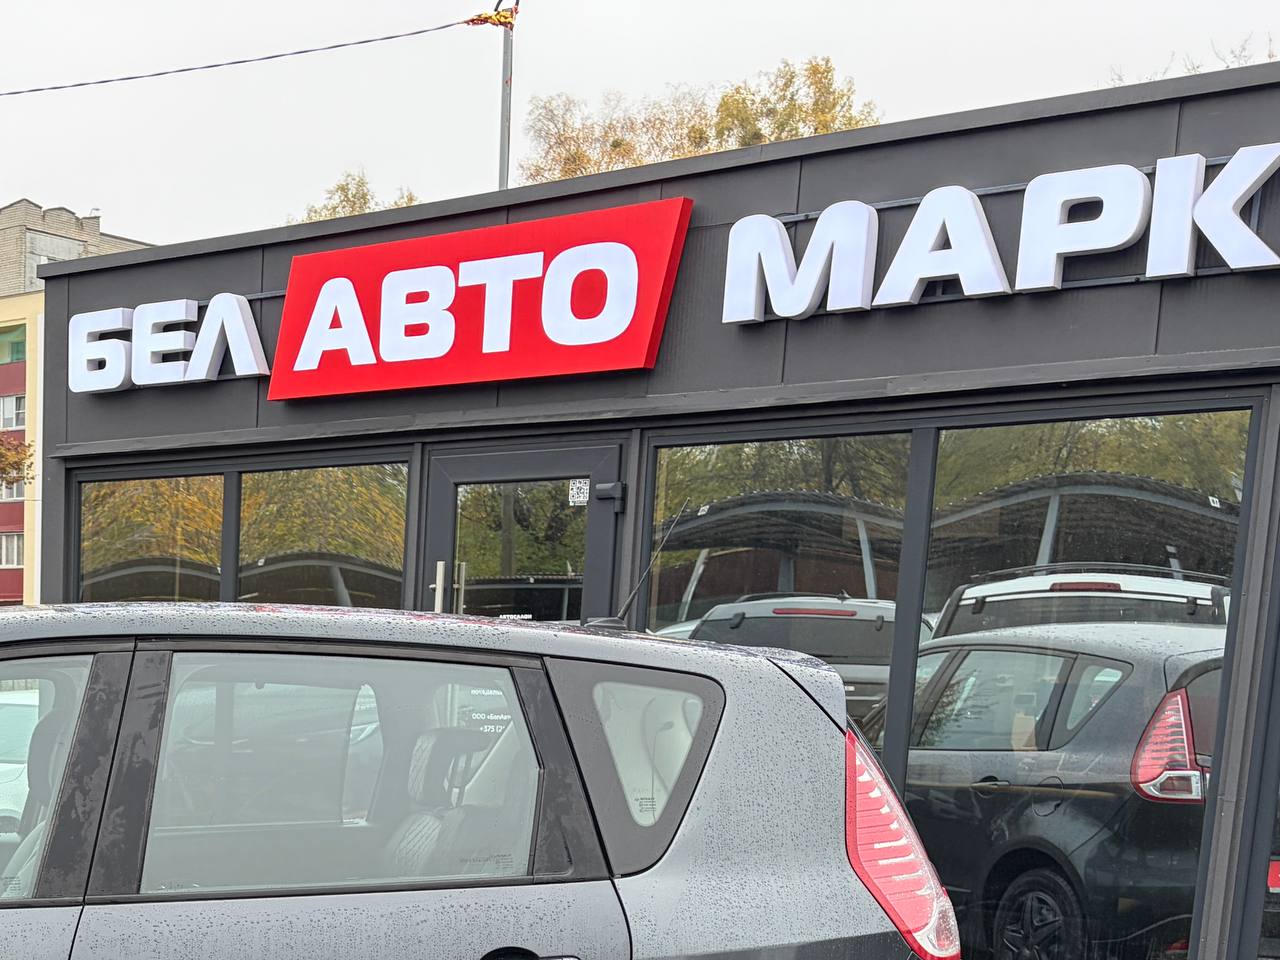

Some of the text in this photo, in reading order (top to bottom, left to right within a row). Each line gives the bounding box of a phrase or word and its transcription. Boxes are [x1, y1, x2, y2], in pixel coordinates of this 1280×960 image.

[68, 142, 1280, 393] БЕЛ АВТО МАРК
